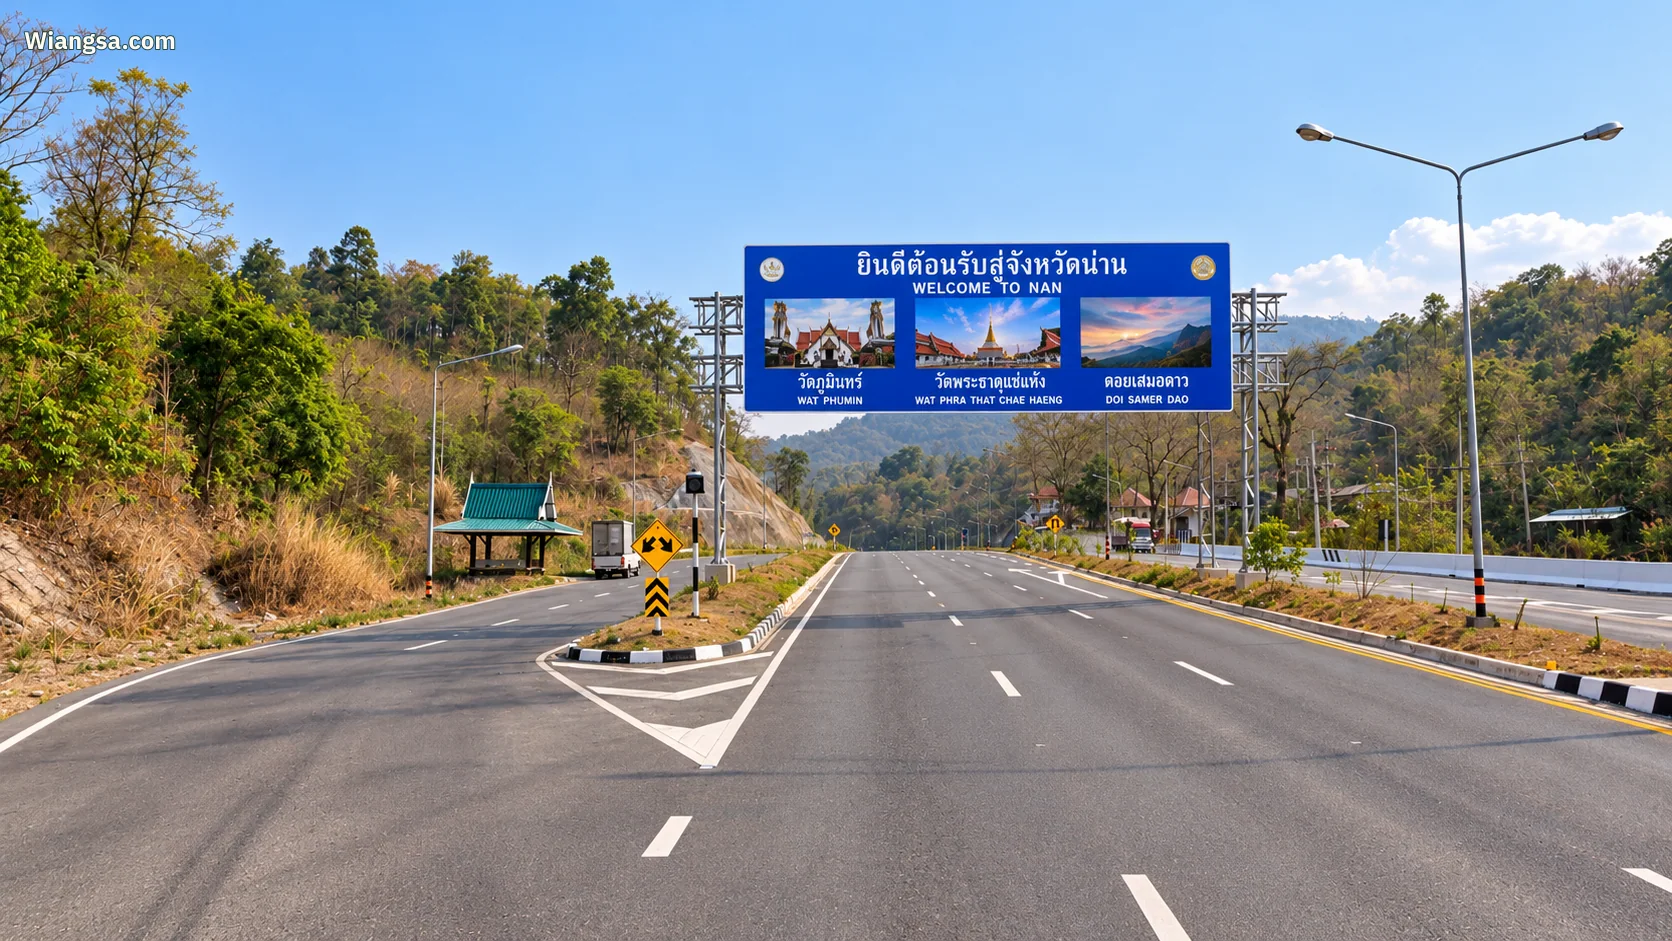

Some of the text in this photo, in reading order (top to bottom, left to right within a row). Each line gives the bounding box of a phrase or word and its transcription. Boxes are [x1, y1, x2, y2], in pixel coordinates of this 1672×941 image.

[857, 250, 1128, 283] ยินดีต้อนรับสู่จังหวัดน่าน
[912, 281, 1062, 294] WELCOME TO NAN
[797, 371, 863, 395] วัดภูมินทร์
[1104, 374, 1189, 389] ดอยเสมอดาว
[797, 396, 863, 405] WAT PHUMIN
[914, 395, 1063, 405] WAT PHRA THAT CHAE HAENG
[1105, 395, 1189, 405] DOI SAMER DAO
